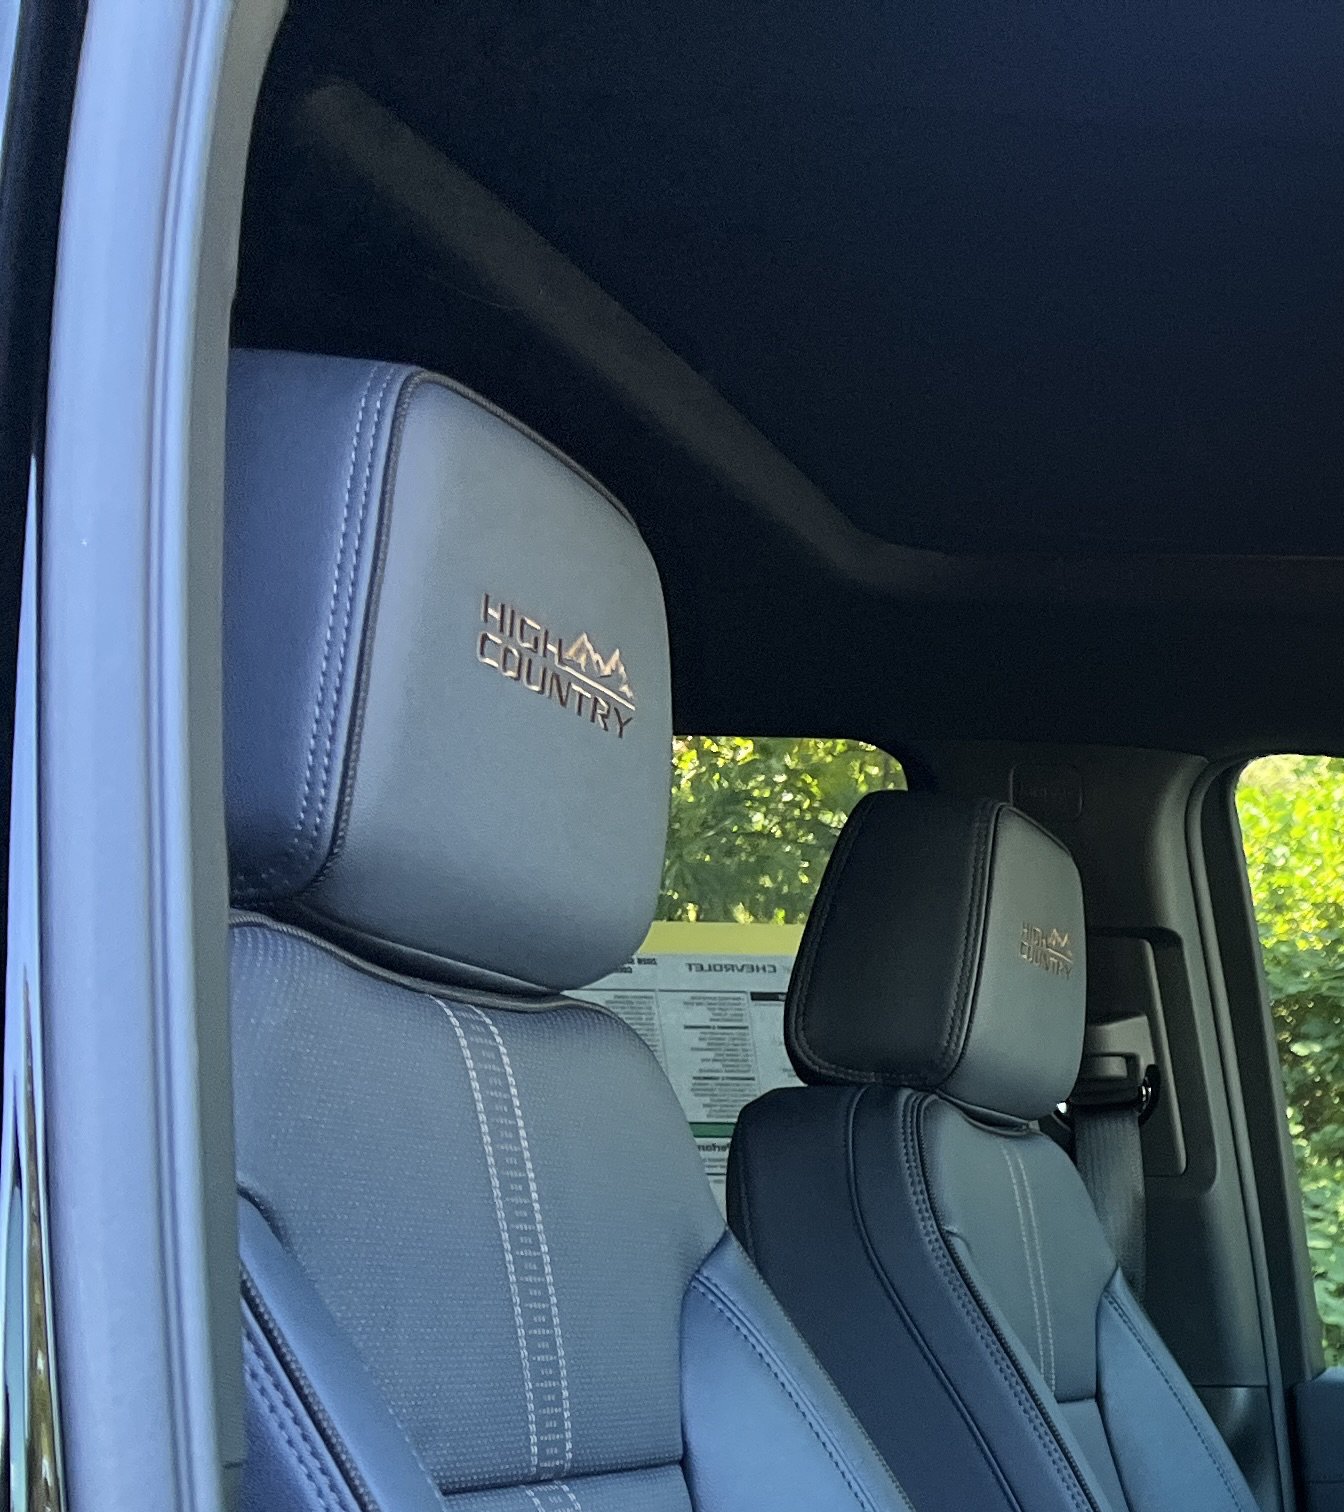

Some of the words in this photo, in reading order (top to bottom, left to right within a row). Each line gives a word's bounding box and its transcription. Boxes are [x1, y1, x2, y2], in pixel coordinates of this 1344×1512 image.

[481, 593, 564, 666] HIGH
[477, 631, 634, 739] COUNTRY
[1019, 940, 1073, 980] COUNTRY
